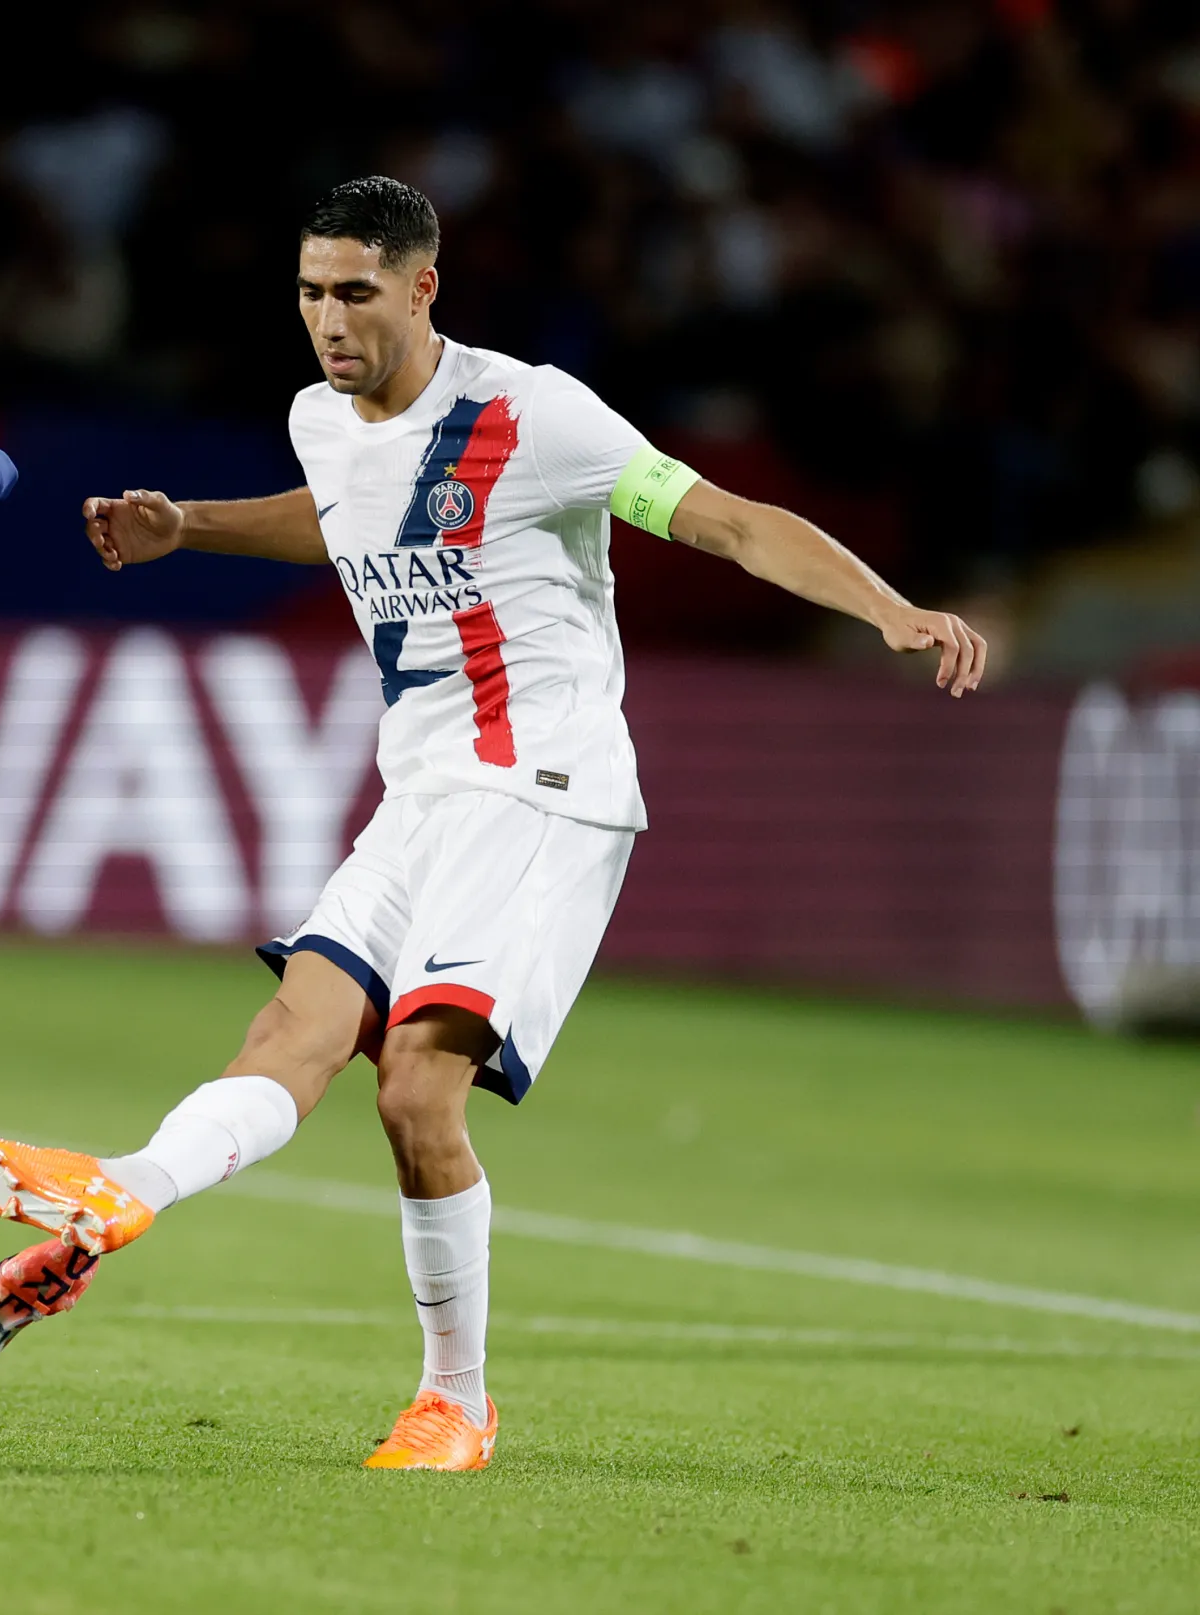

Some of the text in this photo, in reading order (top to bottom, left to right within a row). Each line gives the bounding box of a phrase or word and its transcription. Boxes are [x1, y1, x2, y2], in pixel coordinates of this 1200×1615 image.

[433, 483, 465, 496] PARIS
[335, 548, 475, 602] QATAR
[370, 584, 482, 620] AIRWAYS
